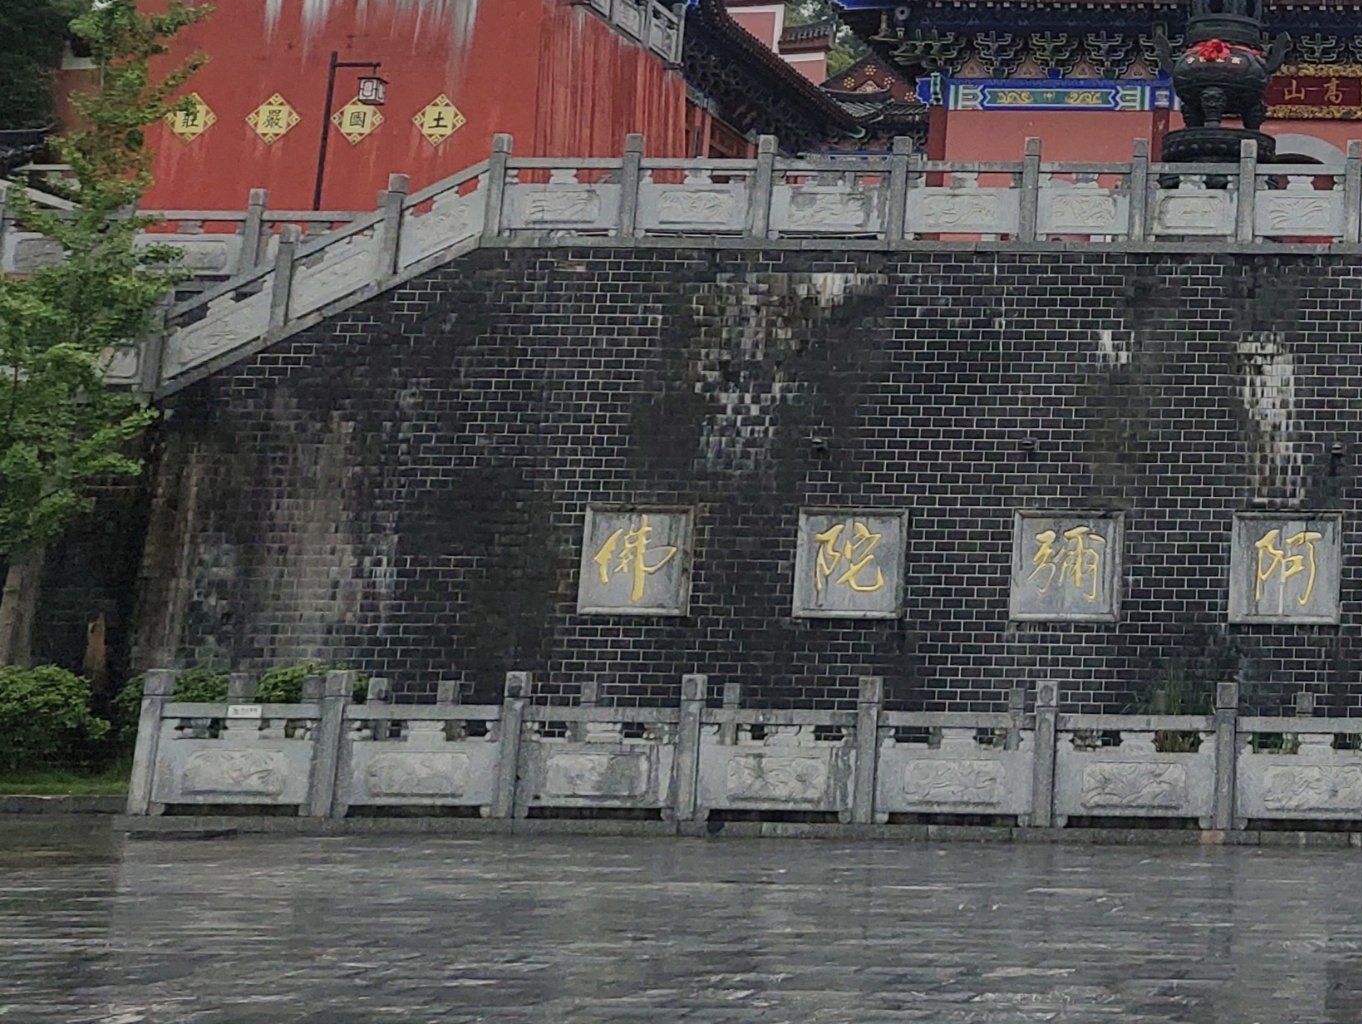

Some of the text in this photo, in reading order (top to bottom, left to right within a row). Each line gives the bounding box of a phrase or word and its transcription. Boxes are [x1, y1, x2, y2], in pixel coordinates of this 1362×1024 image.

[427, 110, 449, 130] 土
[593, 513, 677, 605] 佛
[1253, 528, 1322, 608] 阿
